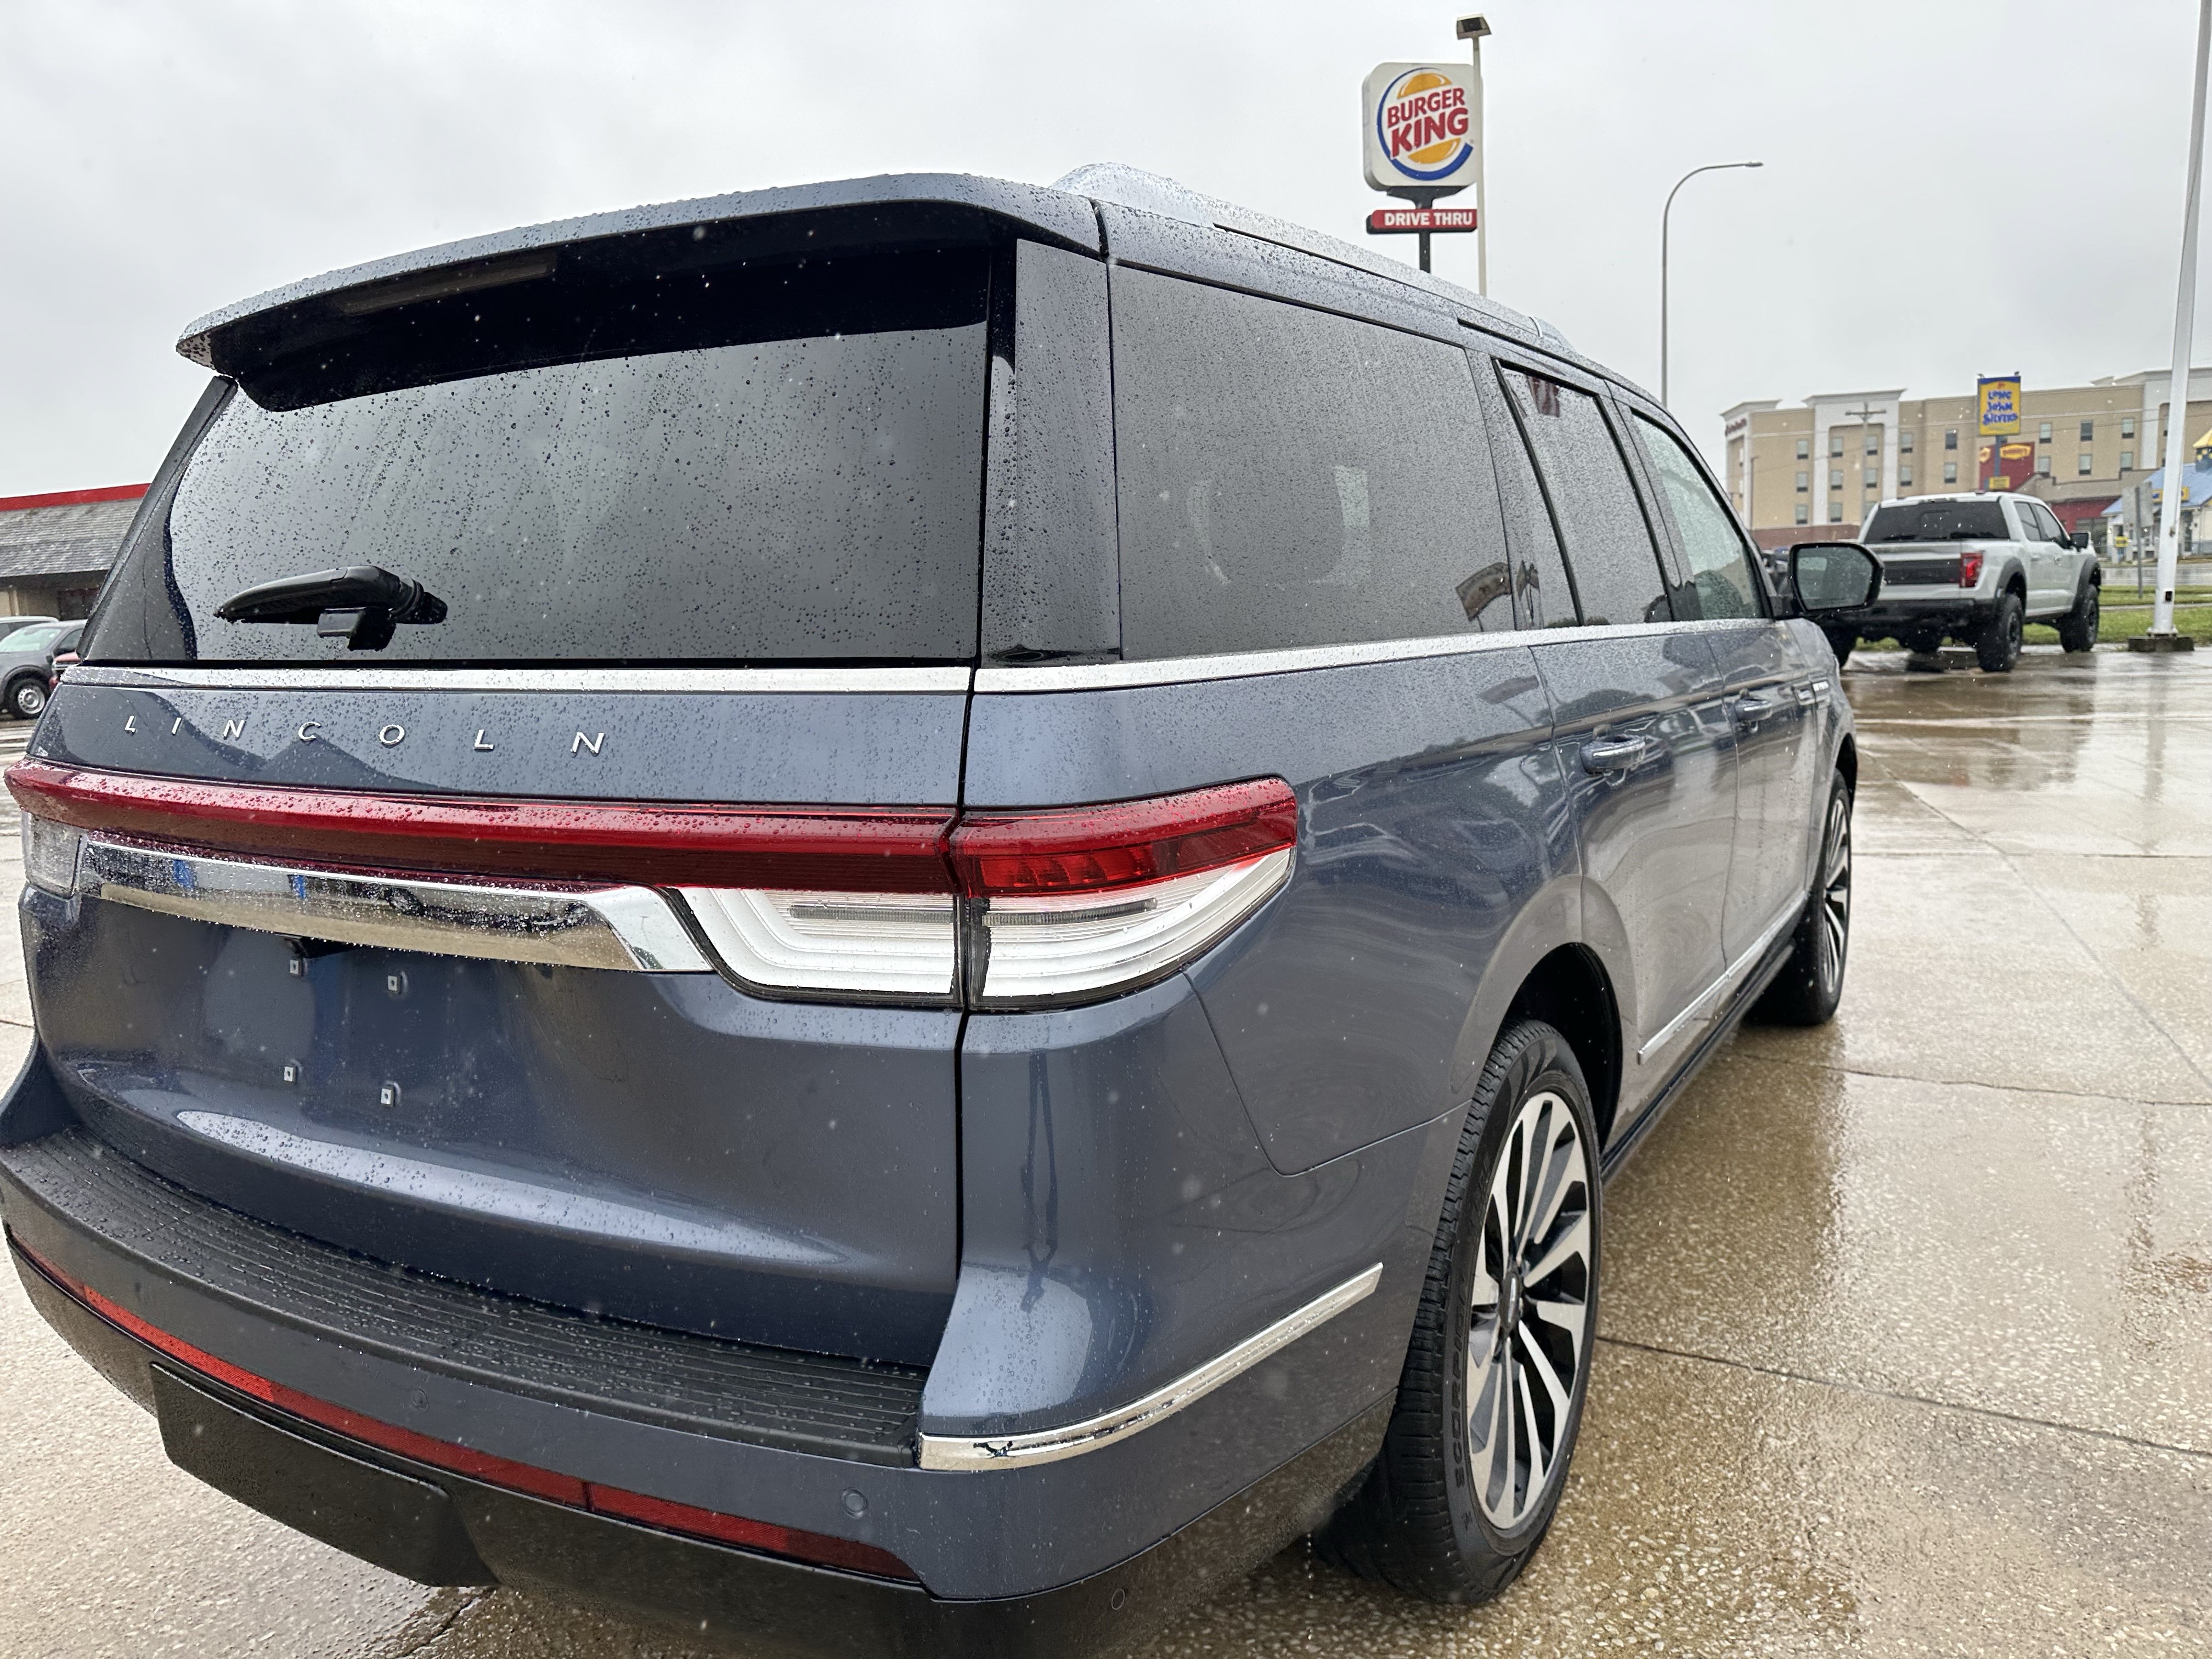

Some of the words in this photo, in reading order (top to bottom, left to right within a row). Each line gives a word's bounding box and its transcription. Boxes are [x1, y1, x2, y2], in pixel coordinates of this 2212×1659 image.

[1387, 88, 1465, 128] BURGER
[1391, 108, 1468, 157] KING
[1384, 213, 1430, 226] DRIVE
[1434, 212, 1472, 225] THRU
[125, 715, 605, 755] LINCOLN
